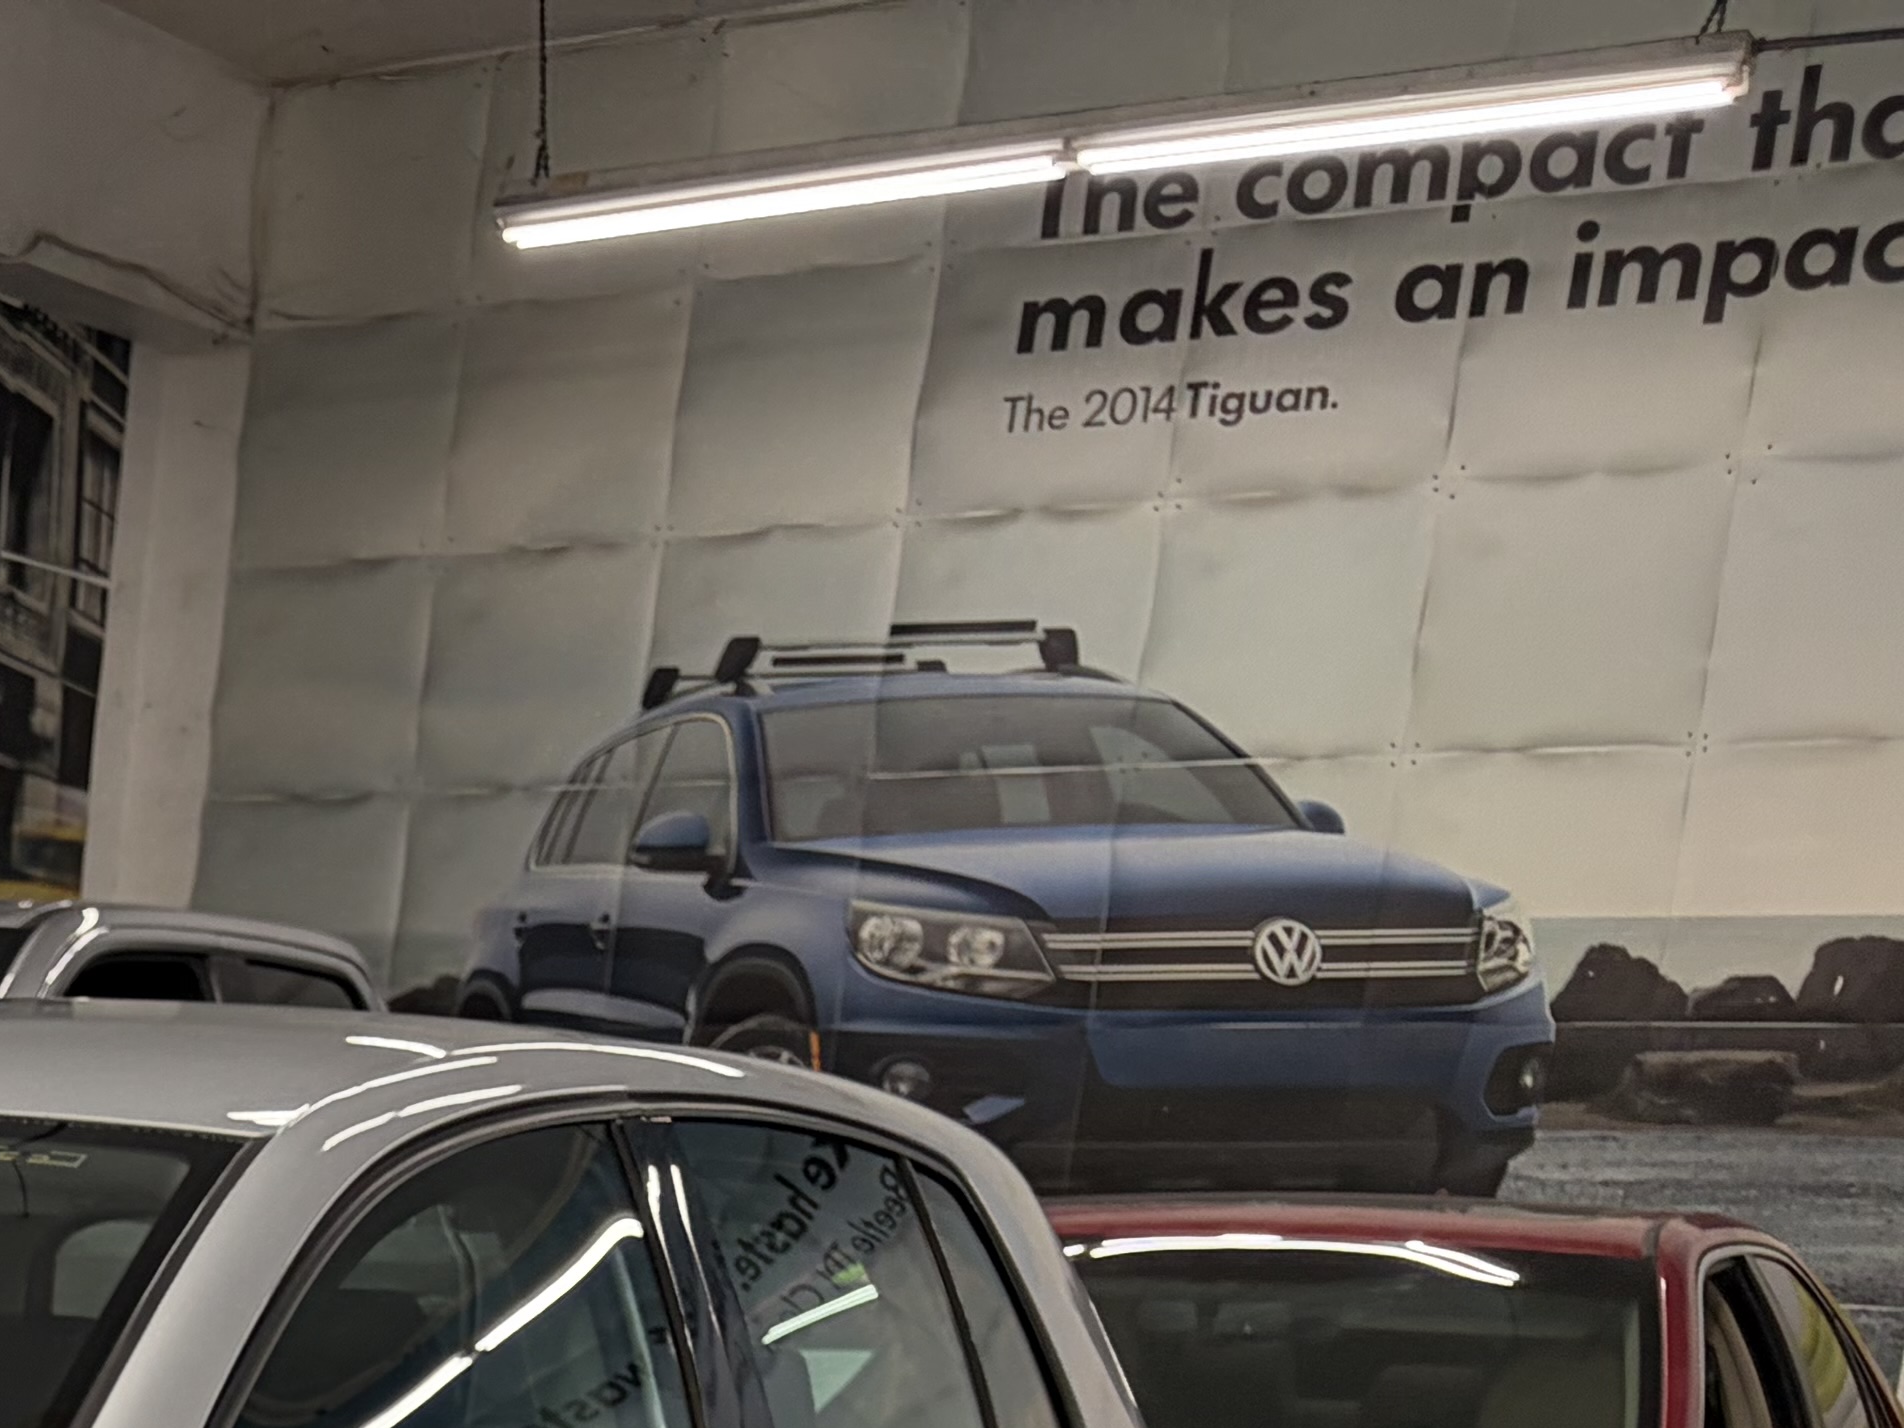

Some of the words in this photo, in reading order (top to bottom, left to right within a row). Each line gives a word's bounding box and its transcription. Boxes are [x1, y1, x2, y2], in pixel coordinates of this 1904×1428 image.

[1236, 115, 1706, 224] compact
[1015, 247, 1354, 354] makes
[1394, 256, 1530, 324] an
[1003, 392, 1070, 433] The
[1081, 384, 1177, 428] 2014
[1186, 380, 1339, 427] Tiguan.
[1256, 918, 1322, 985] VW
